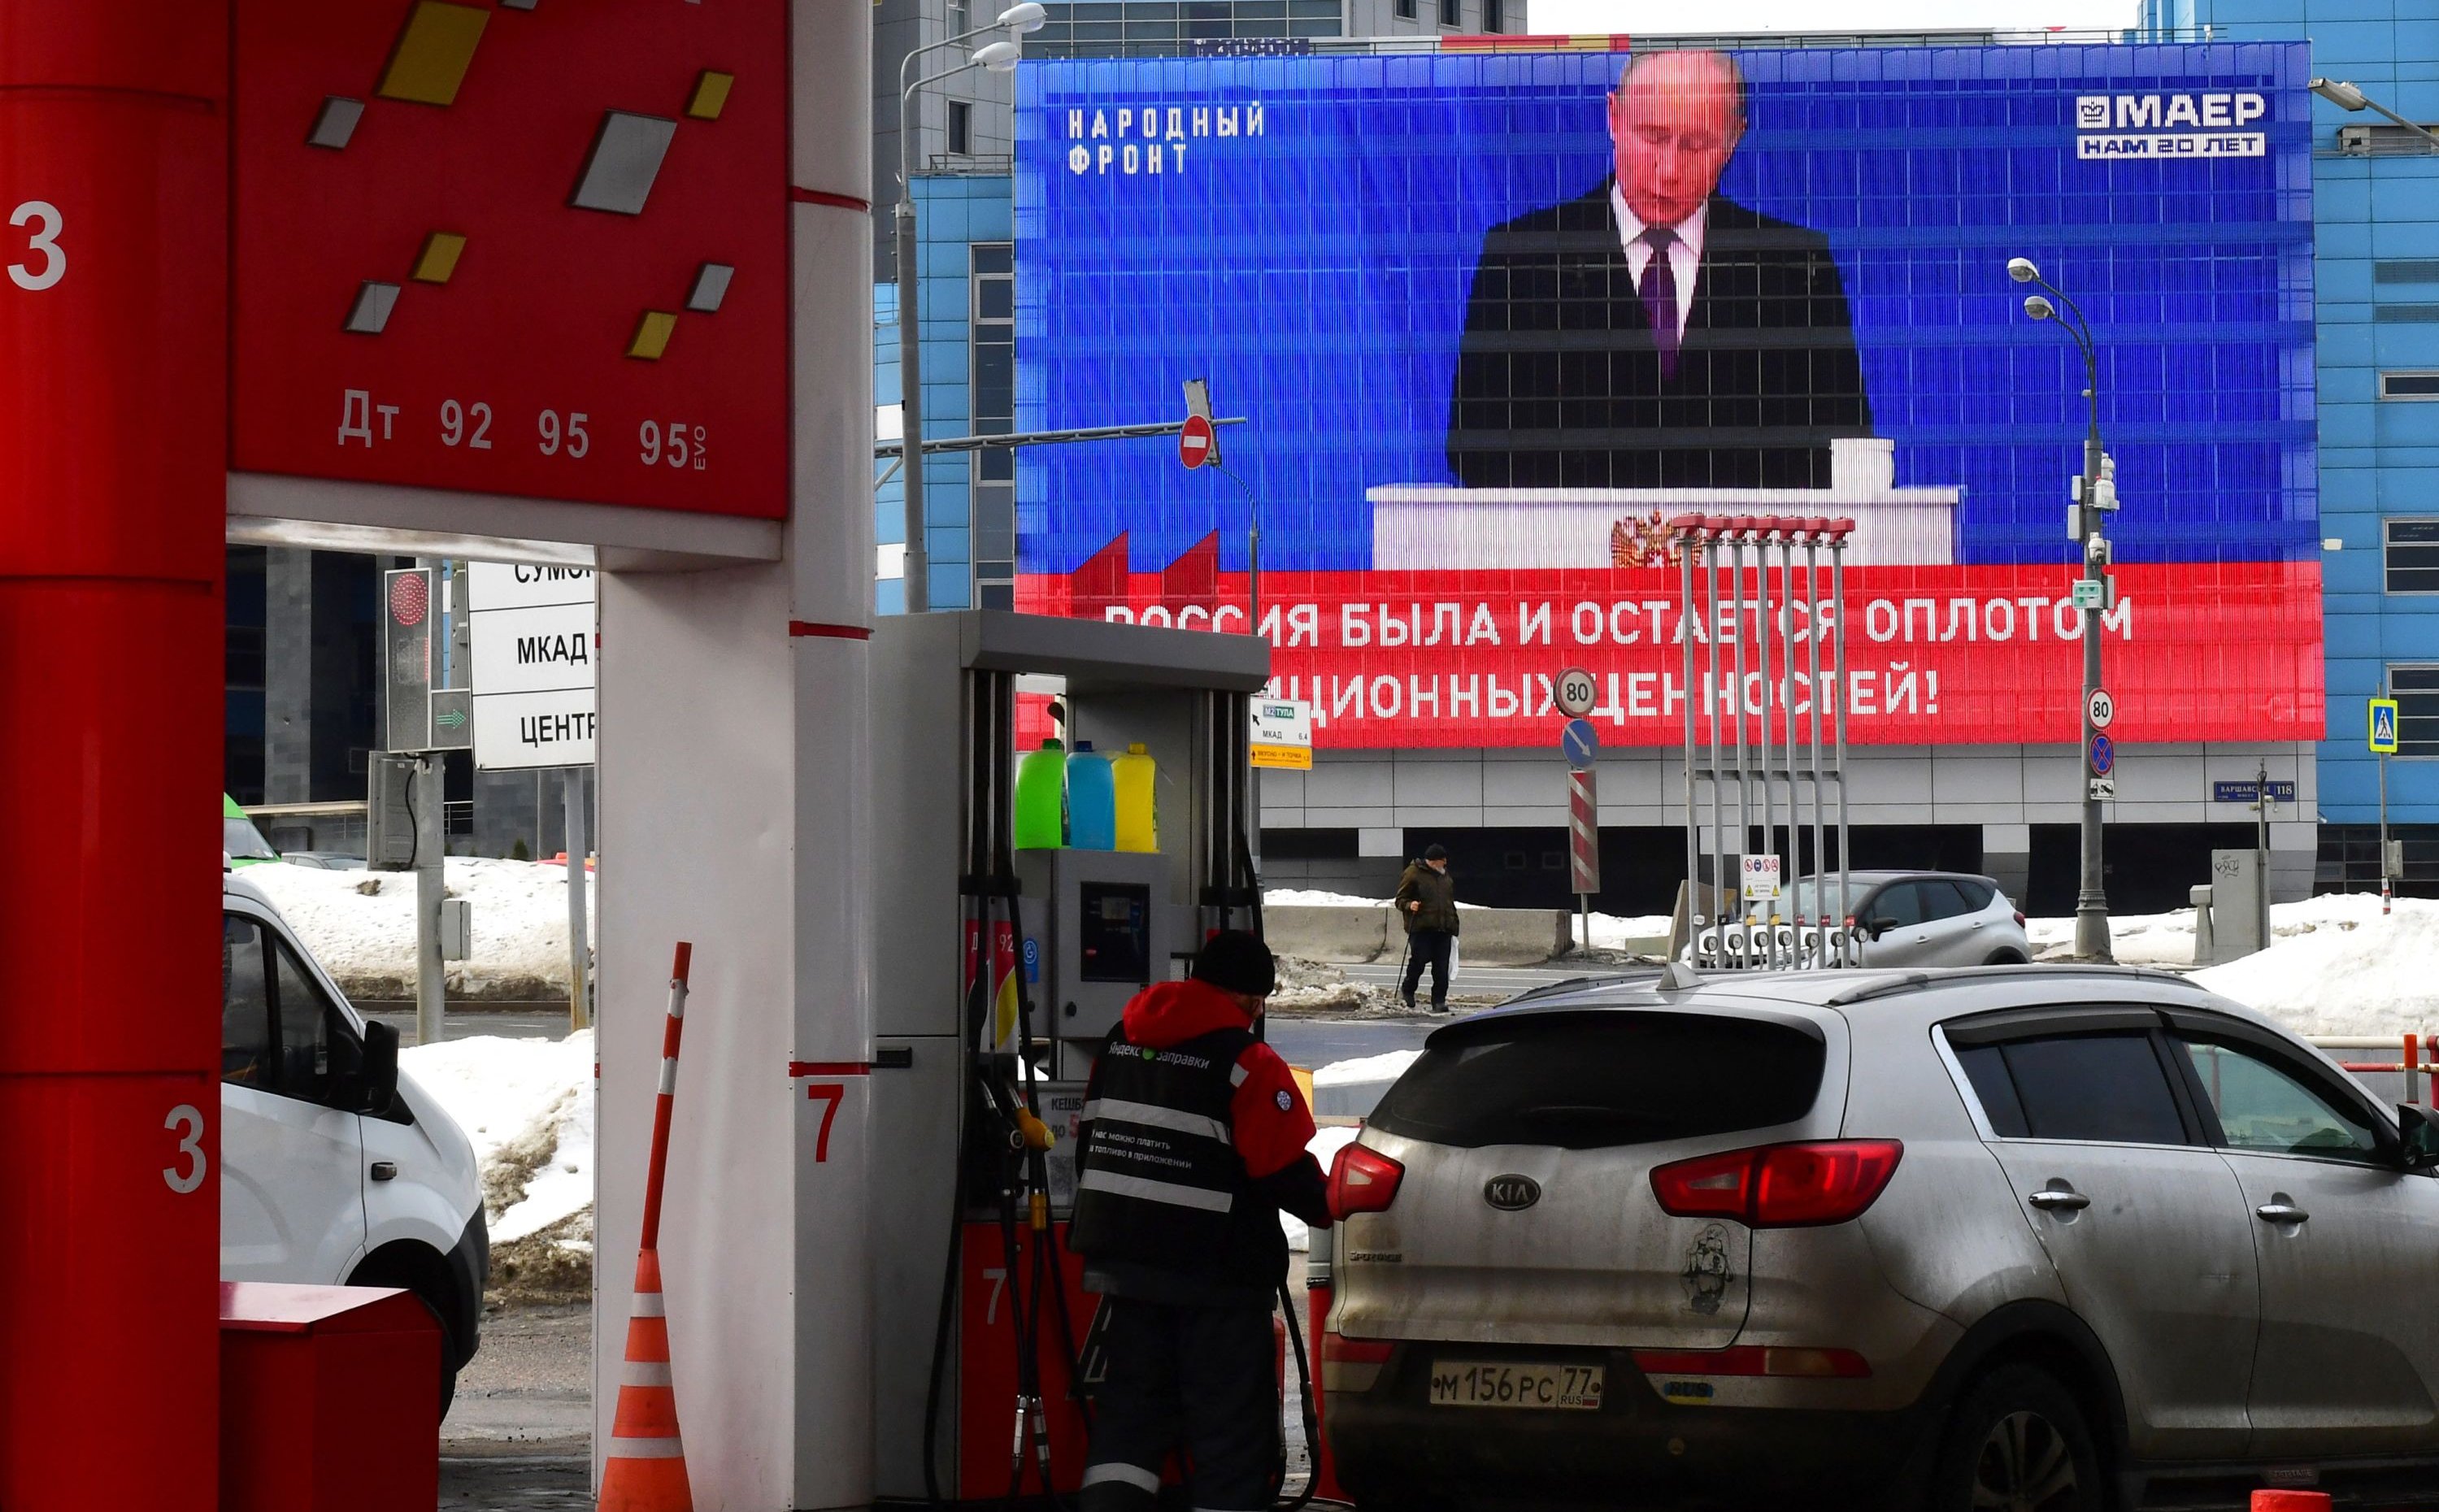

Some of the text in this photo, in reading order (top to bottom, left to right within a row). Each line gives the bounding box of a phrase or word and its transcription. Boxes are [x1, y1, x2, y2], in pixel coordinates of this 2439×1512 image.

[1069, 101, 1263, 141] НАРОДНЫЙ
[2084, 137, 2258, 154] НАМ 20 ЛЕТ
[1069, 144, 1186, 175] ФРОНТ
[7, 200, 67, 292] 3
[337, 388, 689, 468] Дт 92 95 95
[693, 425, 706, 471] EVO
[1341, 602, 1501, 647] БЫЛА
[1519, 602, 1551, 645] И
[1865, 597, 2132, 642] ОПЛОТОМ
[517, 632, 588, 667] МКАД
[1566, 683, 1589, 702] 80
[2093, 701, 2109, 718] 80
[1263, 730, 1282, 741] МКАД
[2276, 784, 2293, 795] 118
[1108, 1041, 1142, 1058] Яндекс
[1051, 1097, 1083, 1110] КЕШБ
[808, 1084, 844, 1162] 7
[163, 1103, 207, 1194] 3
[1107, 1132, 1136, 1144] можно
[1137, 1137, 1171, 1151] платить
[1095, 1145, 1127, 1158] топливо
[1133, 1152, 1193, 1170] приложении
[1492, 1183, 1528, 1201] KIA
[982, 1268, 1007, 1325] 7
[1564, 1367, 1593, 1395] 77
[1560, 1396, 1582, 1406] RUS
